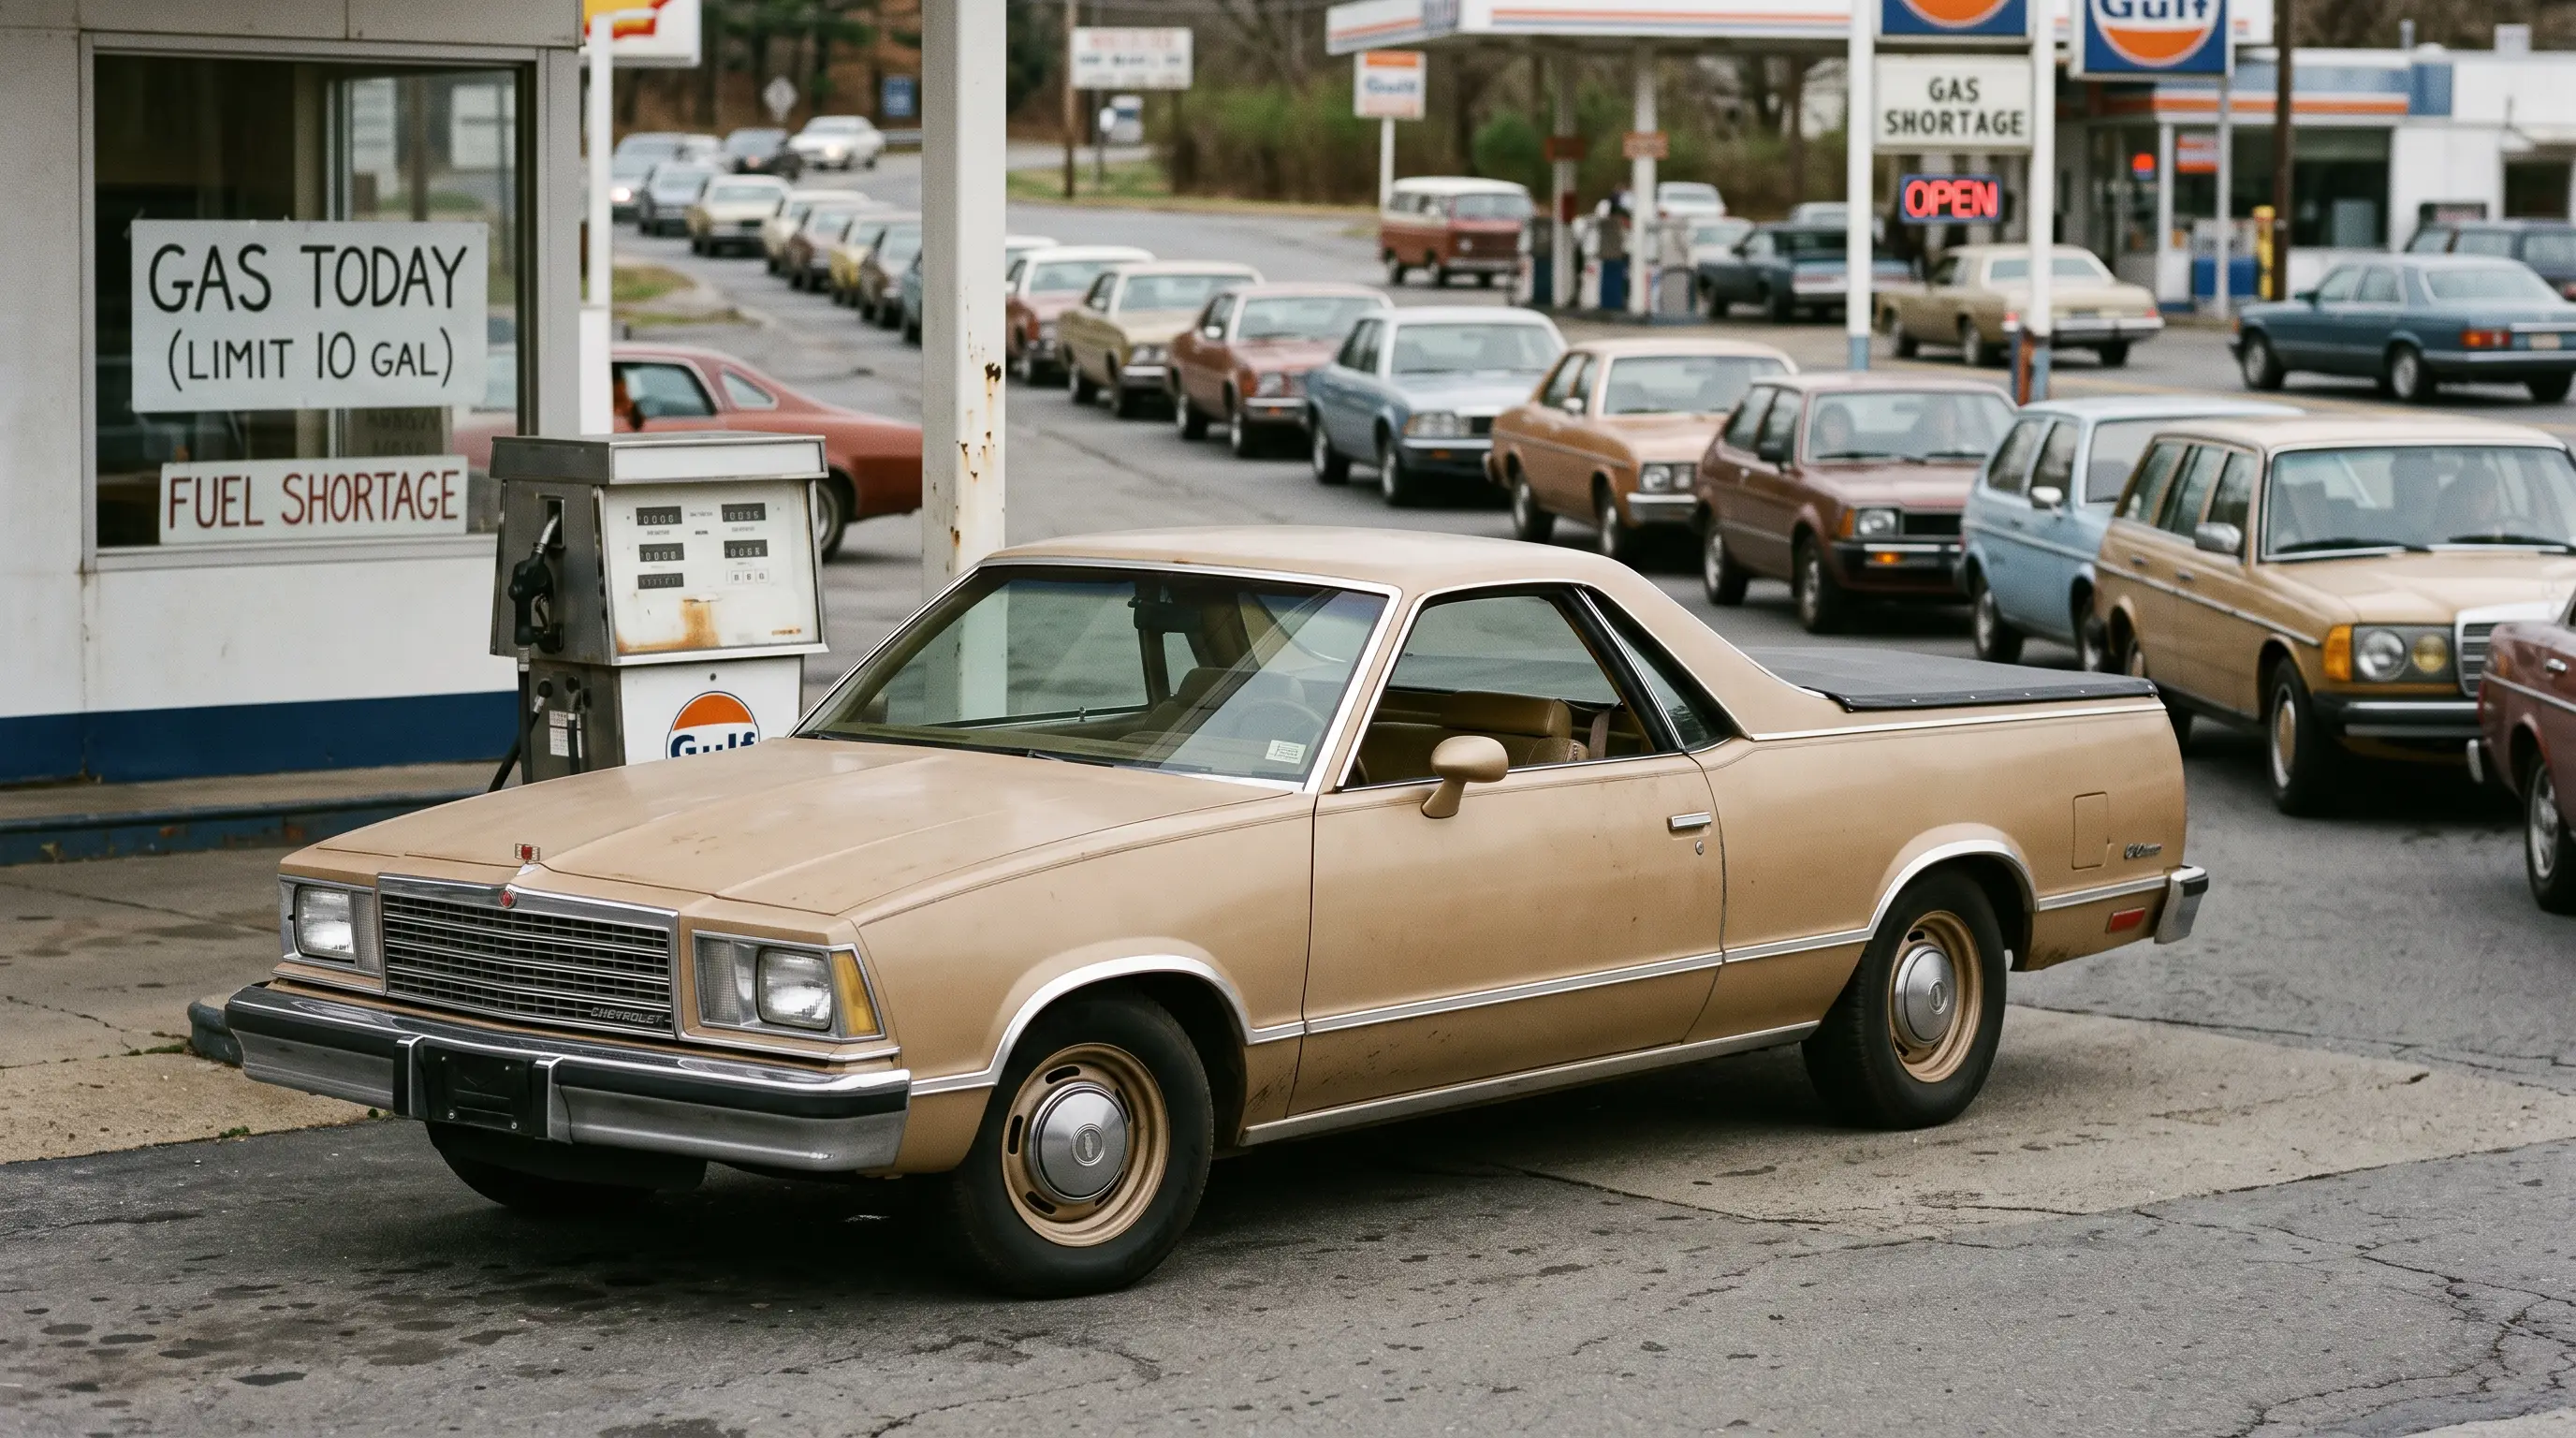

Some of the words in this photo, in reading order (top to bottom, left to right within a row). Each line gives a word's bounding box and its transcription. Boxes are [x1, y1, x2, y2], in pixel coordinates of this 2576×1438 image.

[1927, 76, 1980, 103] GAS
[1884, 109, 2025, 136] SHORTAGE
[1904, 180, 1998, 218] OPEN
[149, 243, 271, 313] GAS
[300, 244, 467, 309] TODAY
[168, 328, 294, 392] (LIMIT
[317, 330, 356, 379] 10
[371, 326, 452, 389] GAL)
[168, 475, 265, 530] FUEL
[281, 469, 461, 525] SHORTAGE
